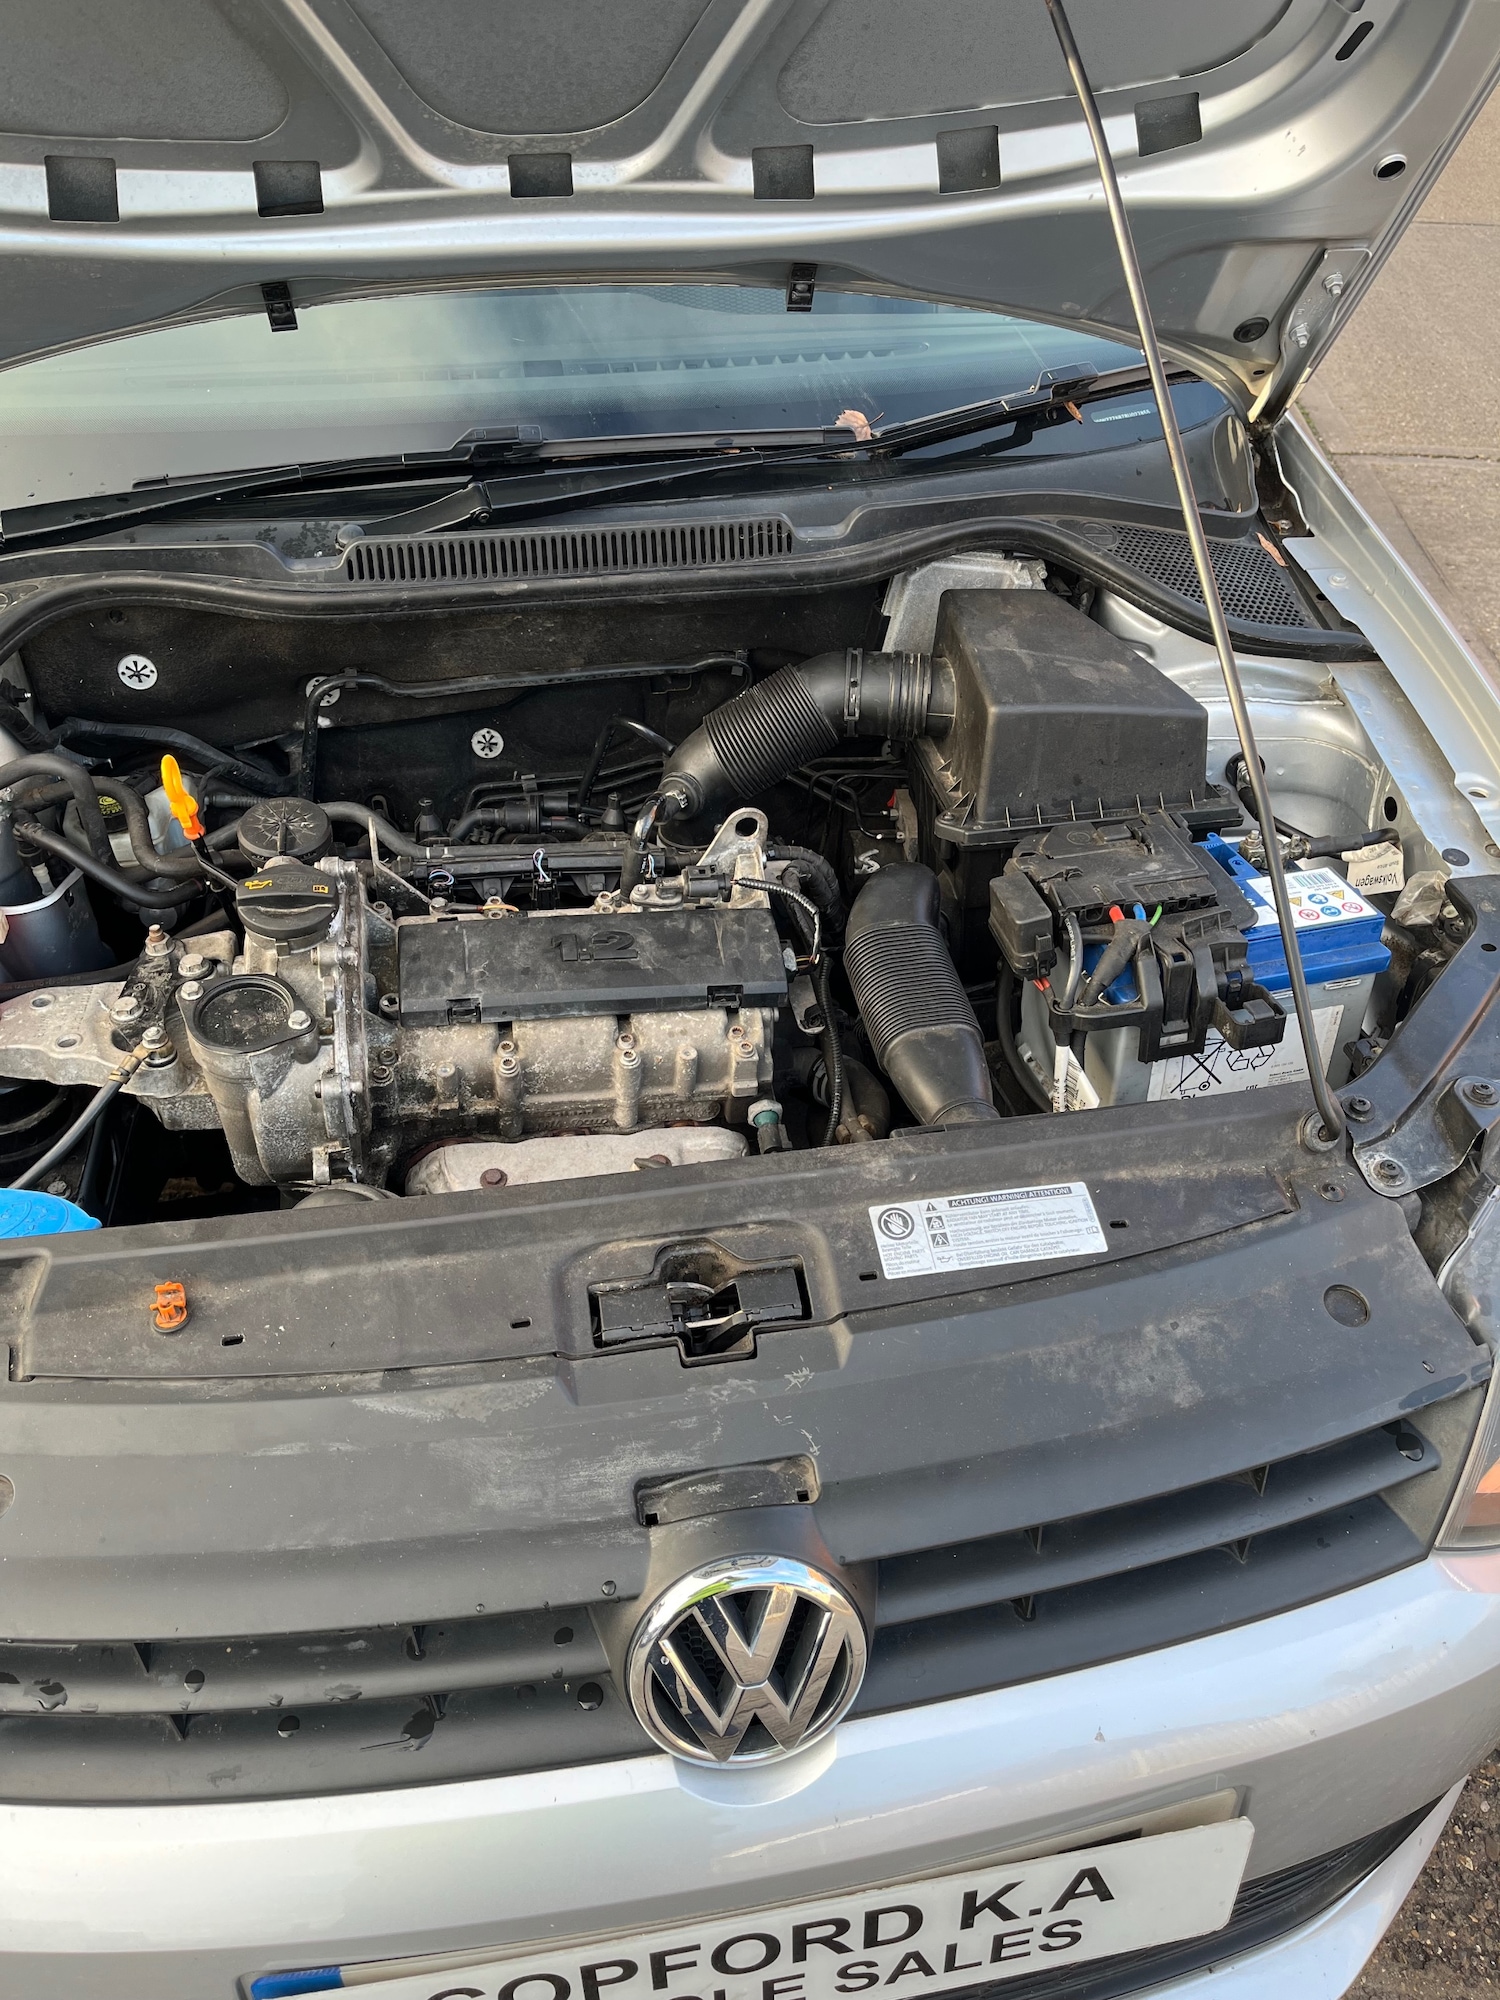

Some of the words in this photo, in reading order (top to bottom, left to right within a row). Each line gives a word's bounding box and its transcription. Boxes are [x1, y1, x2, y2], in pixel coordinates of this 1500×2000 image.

[1355, 872, 1398, 887] Volkswagen
[551, 929, 639, 962] 1.2
[950, 1196, 989, 1206] ACHTUNG!
[989, 1192, 1028, 1202] WARNING!
[1028, 1187, 1069, 1197] ATTENTION!
[960, 1866, 1115, 1931] K.A
[834, 1919, 1083, 1993] SALES
